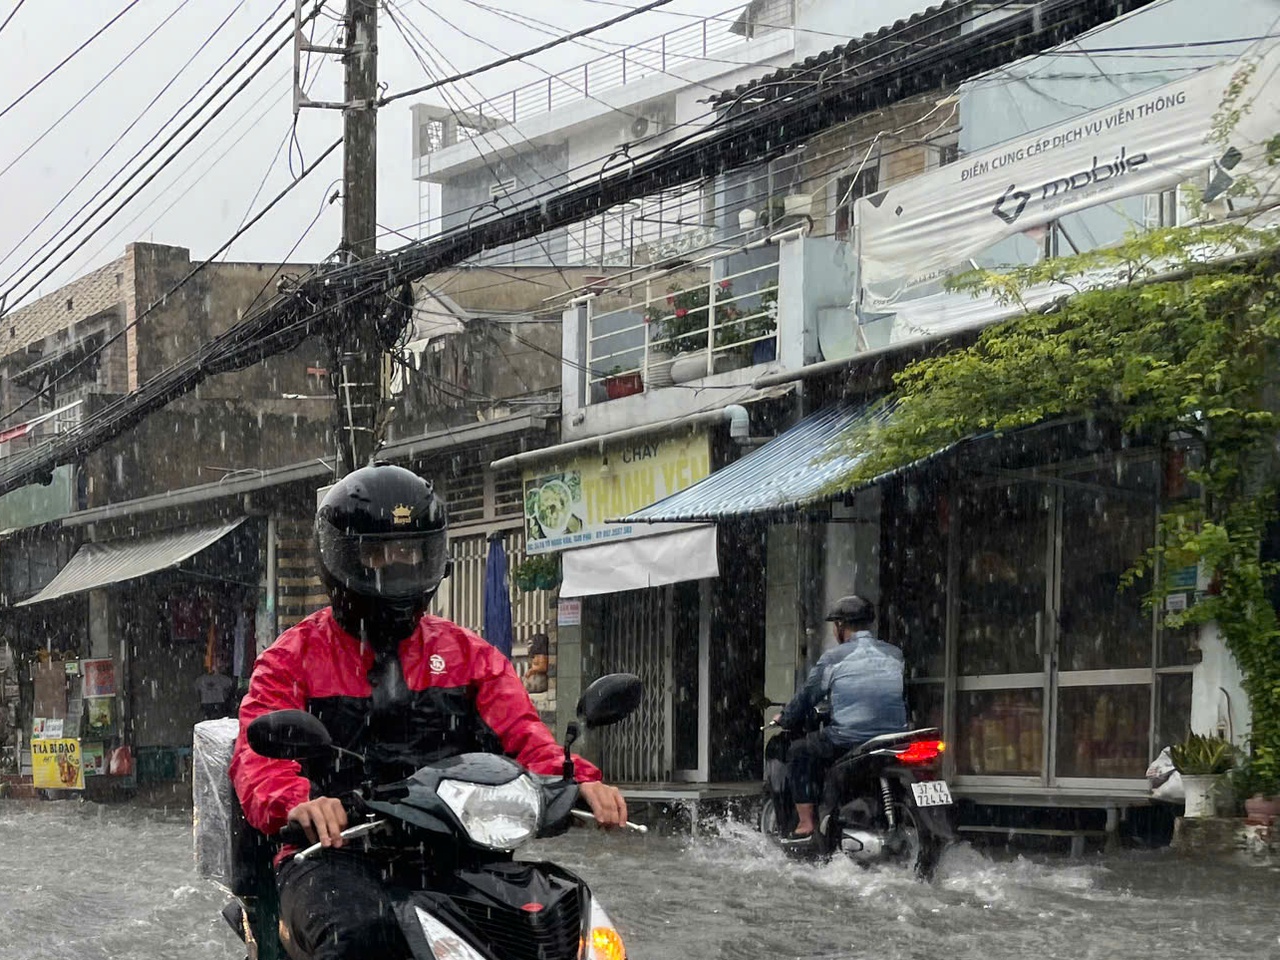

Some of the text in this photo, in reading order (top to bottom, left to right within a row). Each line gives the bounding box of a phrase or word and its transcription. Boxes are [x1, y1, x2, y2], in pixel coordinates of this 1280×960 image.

[961, 91, 1186, 182] ĐIỂM CUNG CẤP DỊCH VỤ VIỄN THÔNG
[1041, 146, 1149, 200] mobile
[623, 443, 660, 464] CHAY
